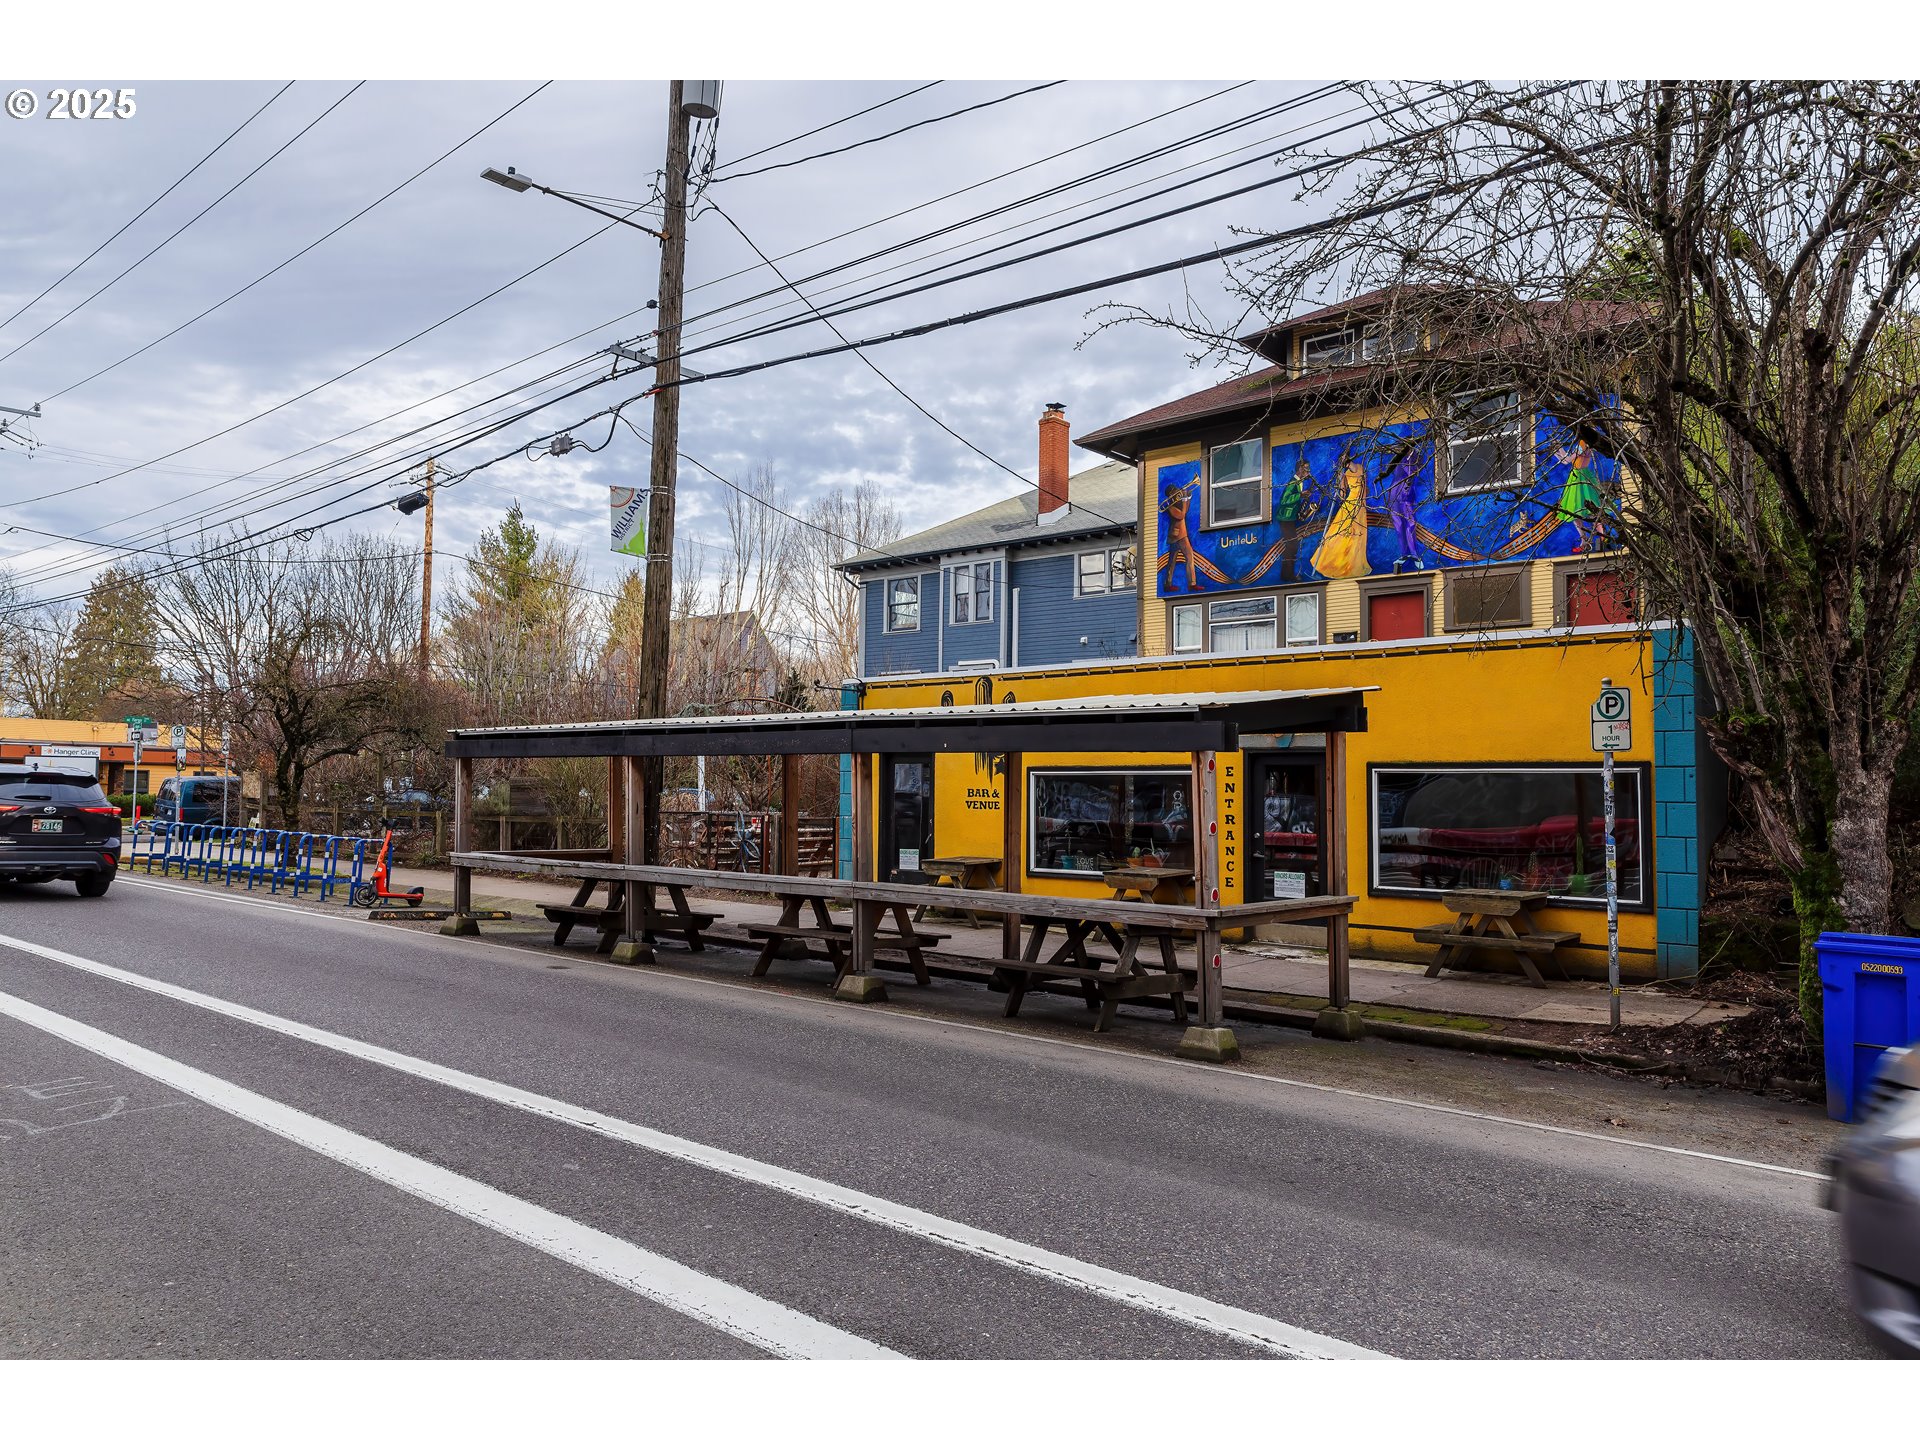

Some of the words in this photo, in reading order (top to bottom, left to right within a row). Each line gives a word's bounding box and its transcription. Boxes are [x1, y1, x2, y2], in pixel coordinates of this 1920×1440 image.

[611, 488, 649, 539] WILLIAMS
[1221, 532, 1258, 549] UniteUs
[1605, 696, 1619, 714] P
[1608, 724, 1613, 735] 1
[53, 748, 79, 756] Hanger
[966, 788, 990, 798] BAR
[991, 788, 1000, 799] &
[965, 800, 1000, 810] VENUE
[1224, 766, 1236, 888] ENTRANCE
[1076, 857, 1094, 865] LOVE
